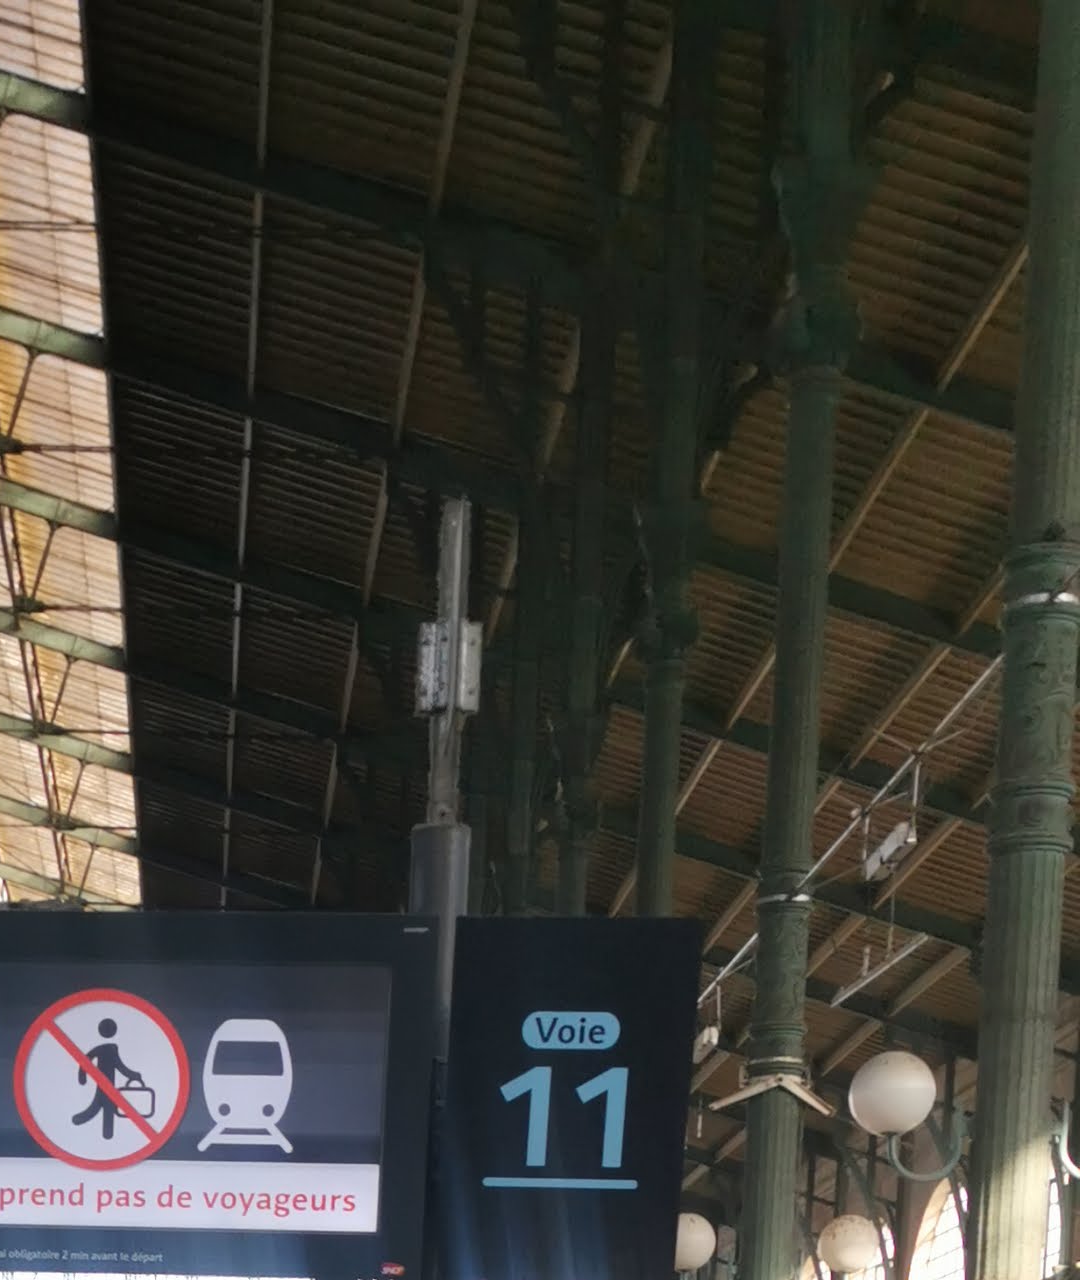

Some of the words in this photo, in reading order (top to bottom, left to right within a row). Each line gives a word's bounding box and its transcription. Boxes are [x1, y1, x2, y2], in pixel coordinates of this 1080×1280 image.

[536, 1017, 605, 1044] Voie
[500, 1066, 628, 1168] 11
[0, 1182, 85, 1212] prend
[97, 1189, 146, 1213] pas
[157, 1184, 193, 1208] de
[204, 1189, 357, 1217] voyageurs
[8, 1248, 60, 1261] obligatoire
[61, 1250, 69, 1260] 2
[70, 1250, 89, 1261] min
[91, 1251, 118, 1261] avant
[120, 1250, 129, 1262] le
[131, 1251, 163, 1264] départ
